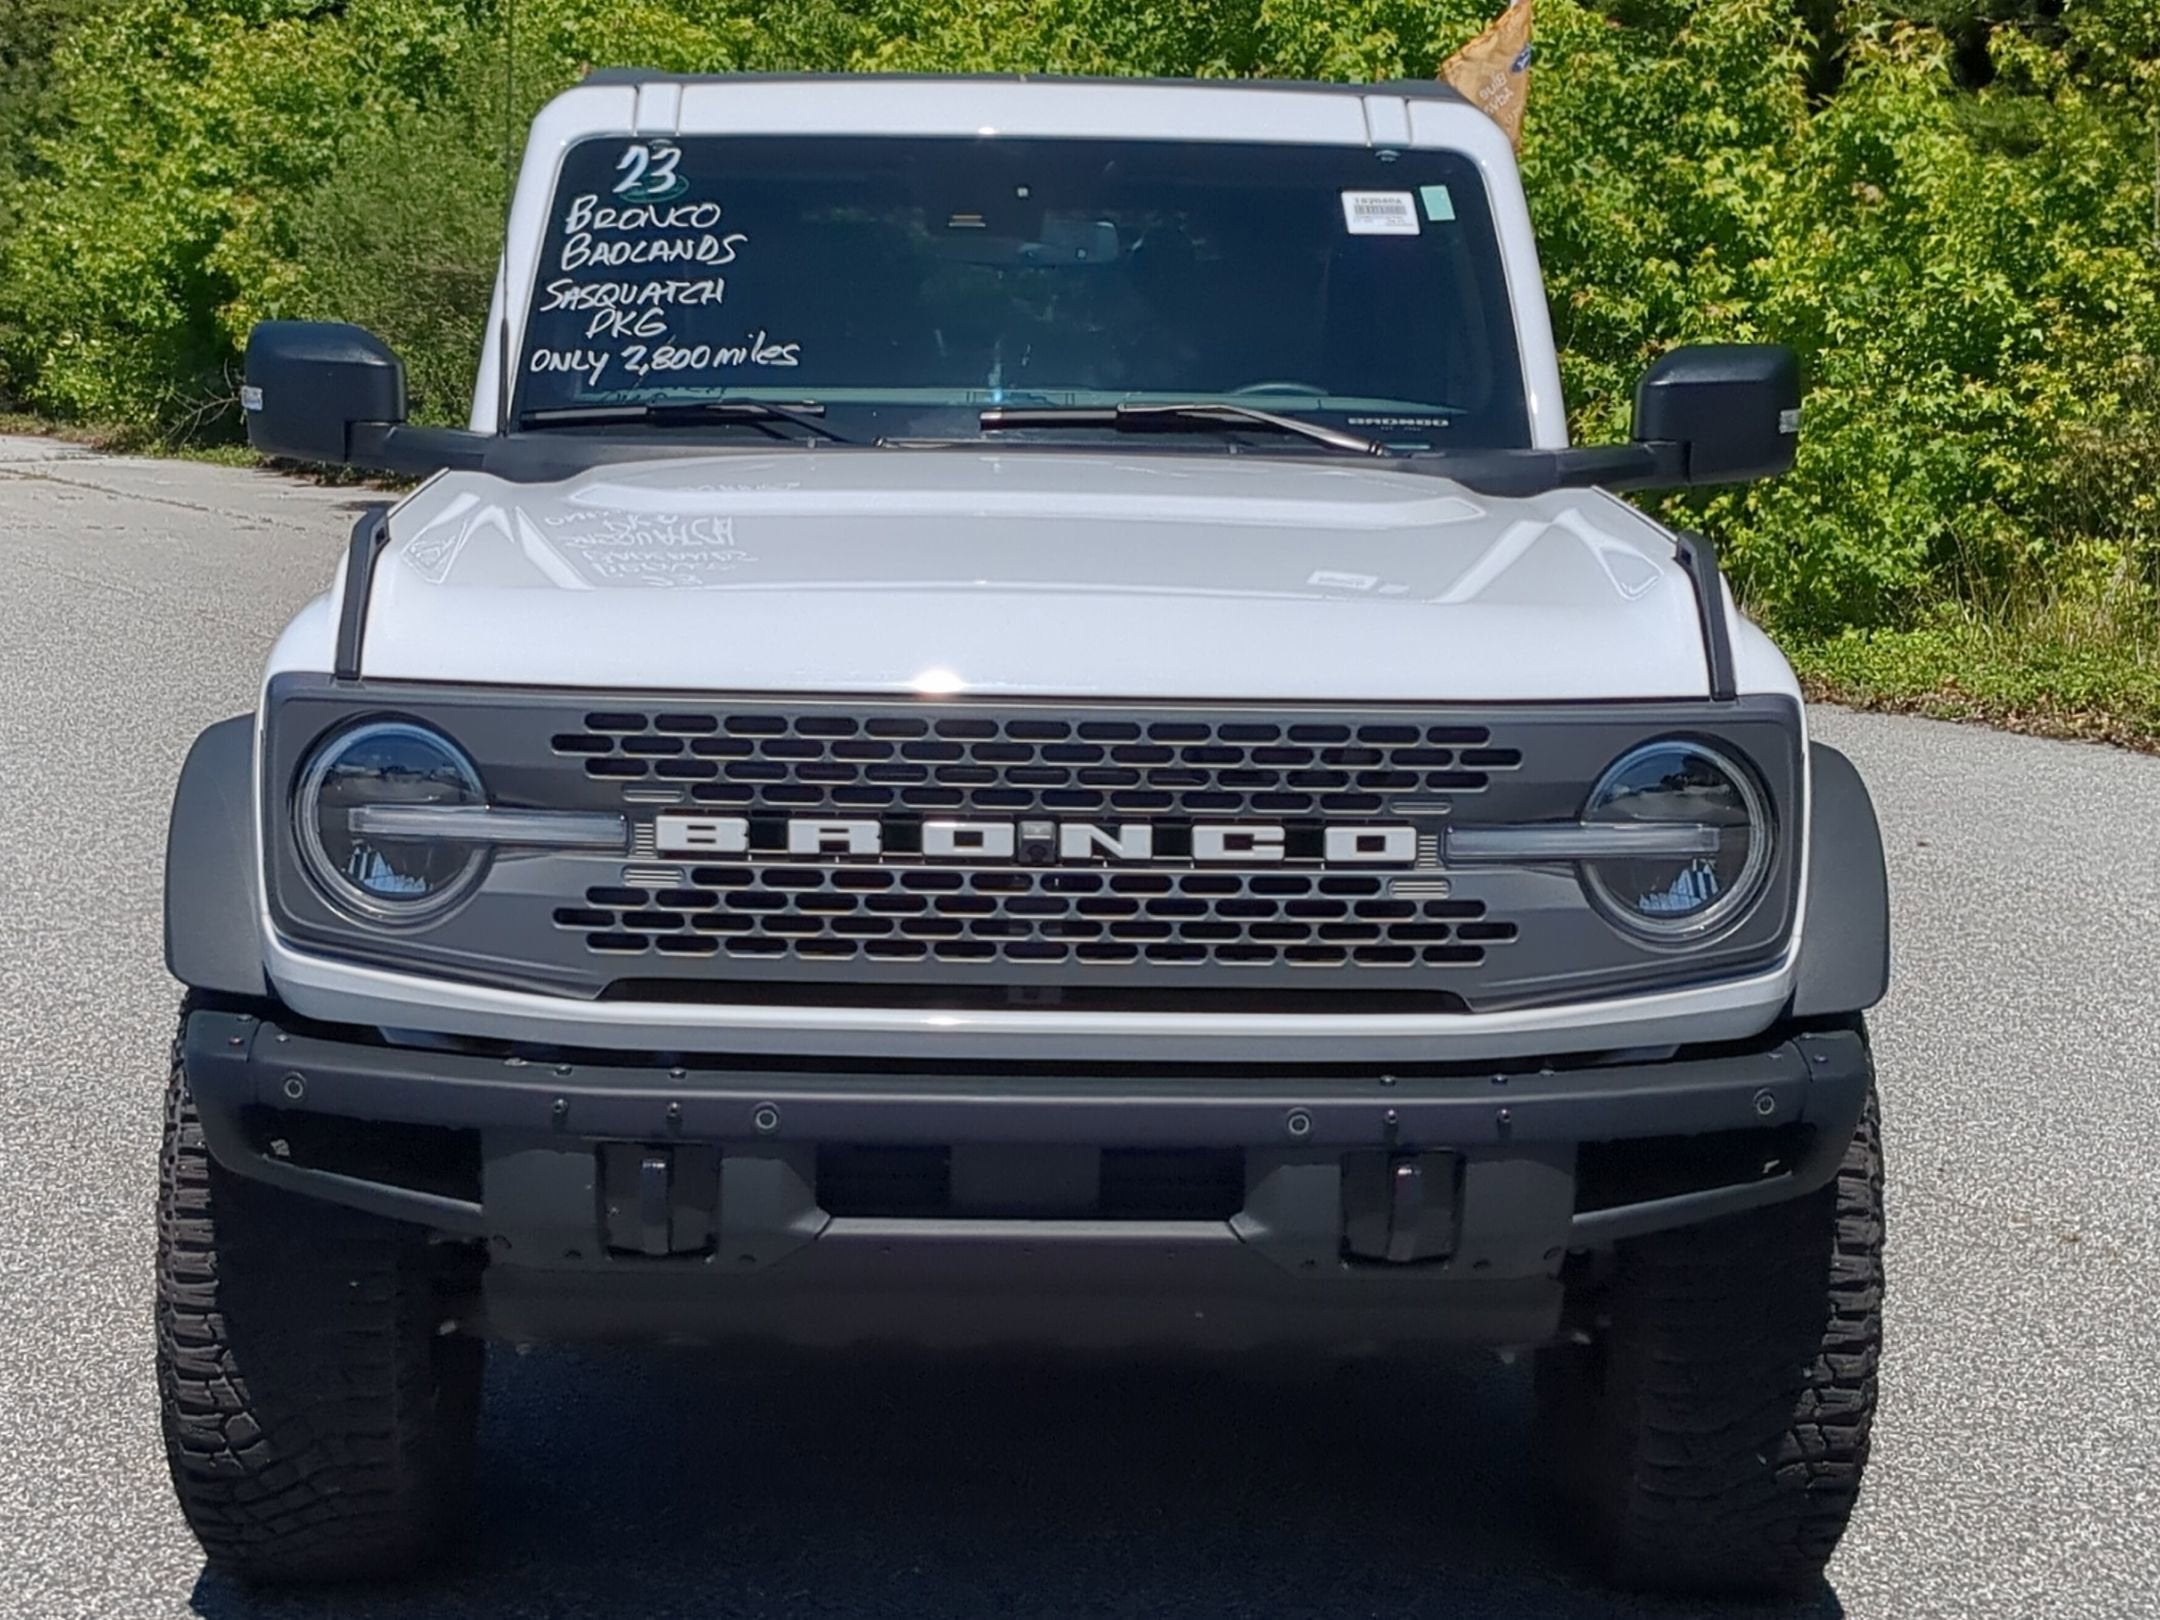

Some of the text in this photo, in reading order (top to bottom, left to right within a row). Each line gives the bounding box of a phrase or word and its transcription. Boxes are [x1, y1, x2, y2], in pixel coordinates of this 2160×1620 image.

[612, 145, 682, 193] 23
[565, 194, 721, 234] BRONCO
[561, 232, 748, 271] BADLANDS
[540, 278, 725, 311] SASQUATCH
[530, 349, 610, 386] ONLY
[655, 815, 1417, 861] BRONCO
